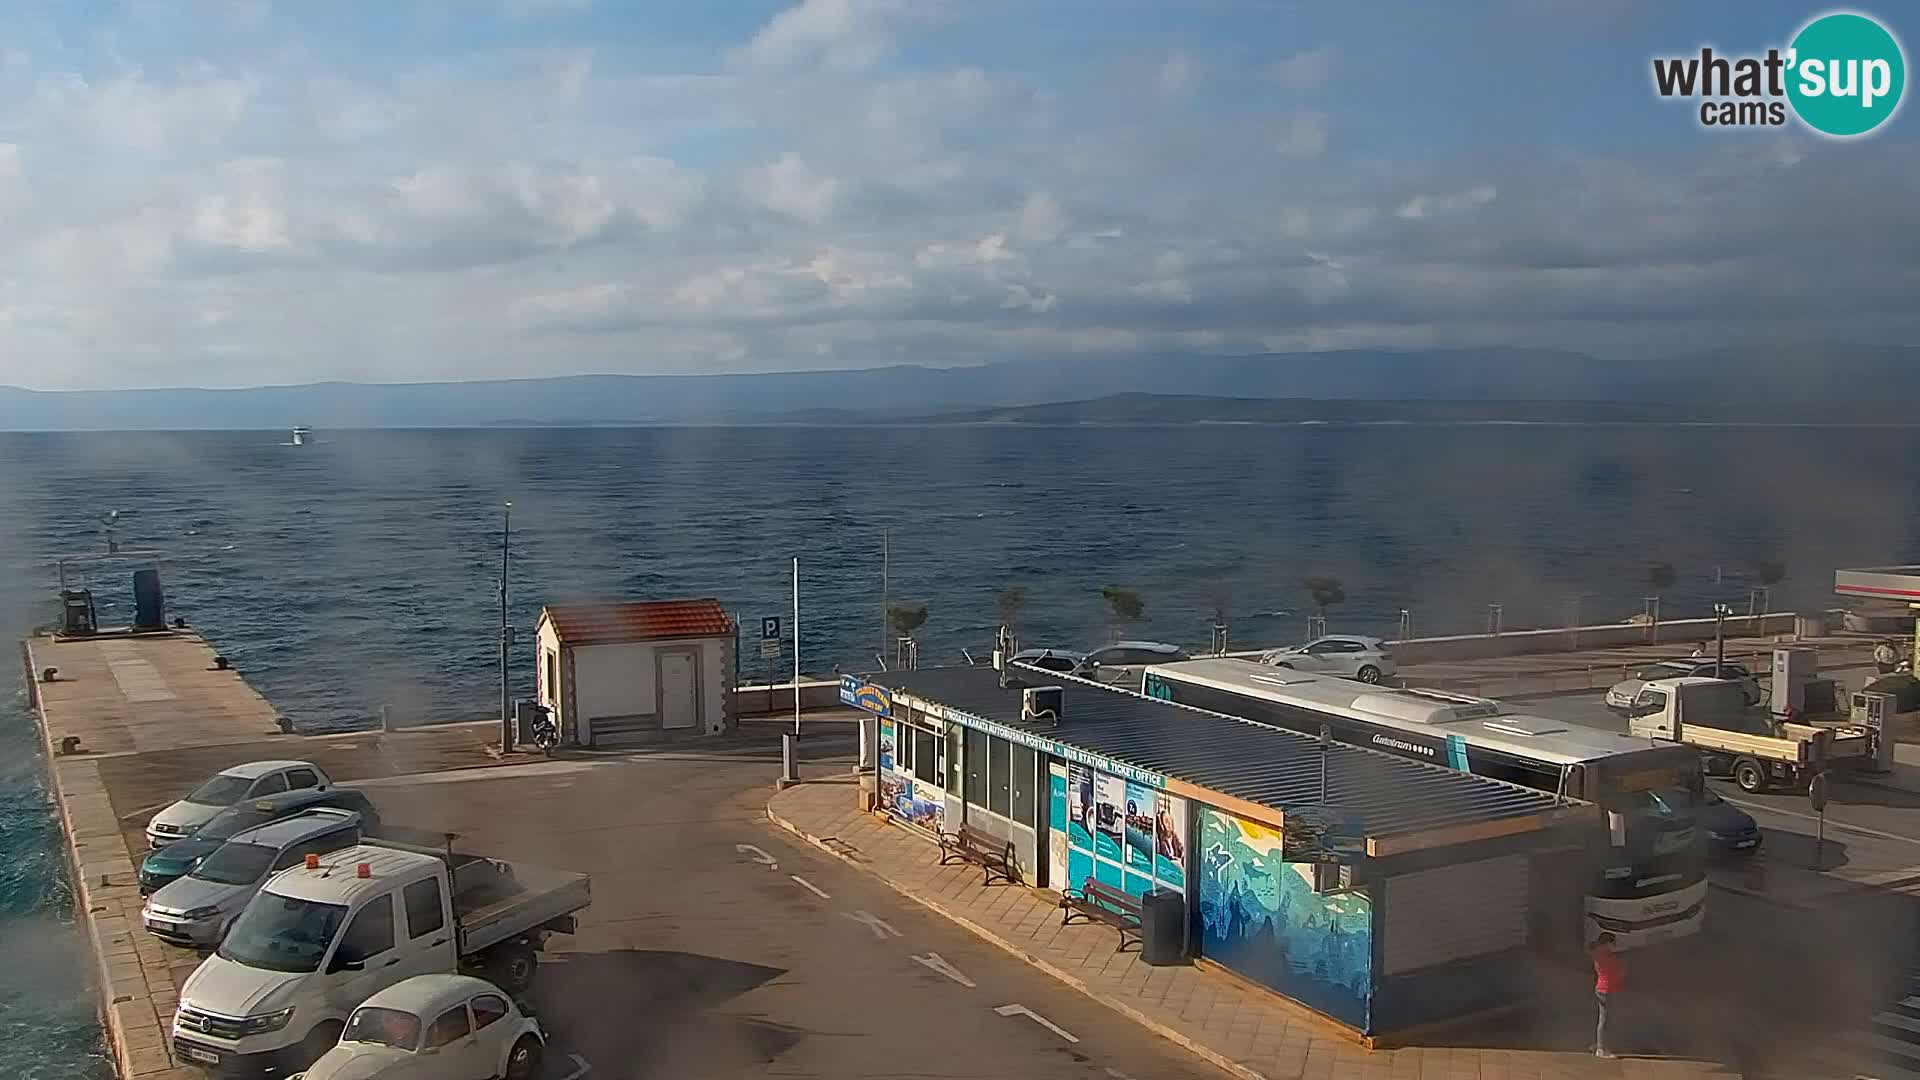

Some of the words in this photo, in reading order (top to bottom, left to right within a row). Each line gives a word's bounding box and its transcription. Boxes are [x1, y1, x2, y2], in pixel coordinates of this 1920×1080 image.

[766, 620, 776, 636] P
[968, 717, 988, 732] KARATA
[989, 724, 1024, 744] AUTOBUSNA
[1025, 737, 1054, 753] POSTAJA
[1063, 747, 1077, 759] BUS
[1078, 751, 1108, 770] STATION
[1110, 760, 1134, 777] TICKET
[1135, 768, 1160, 786] OFFICE
